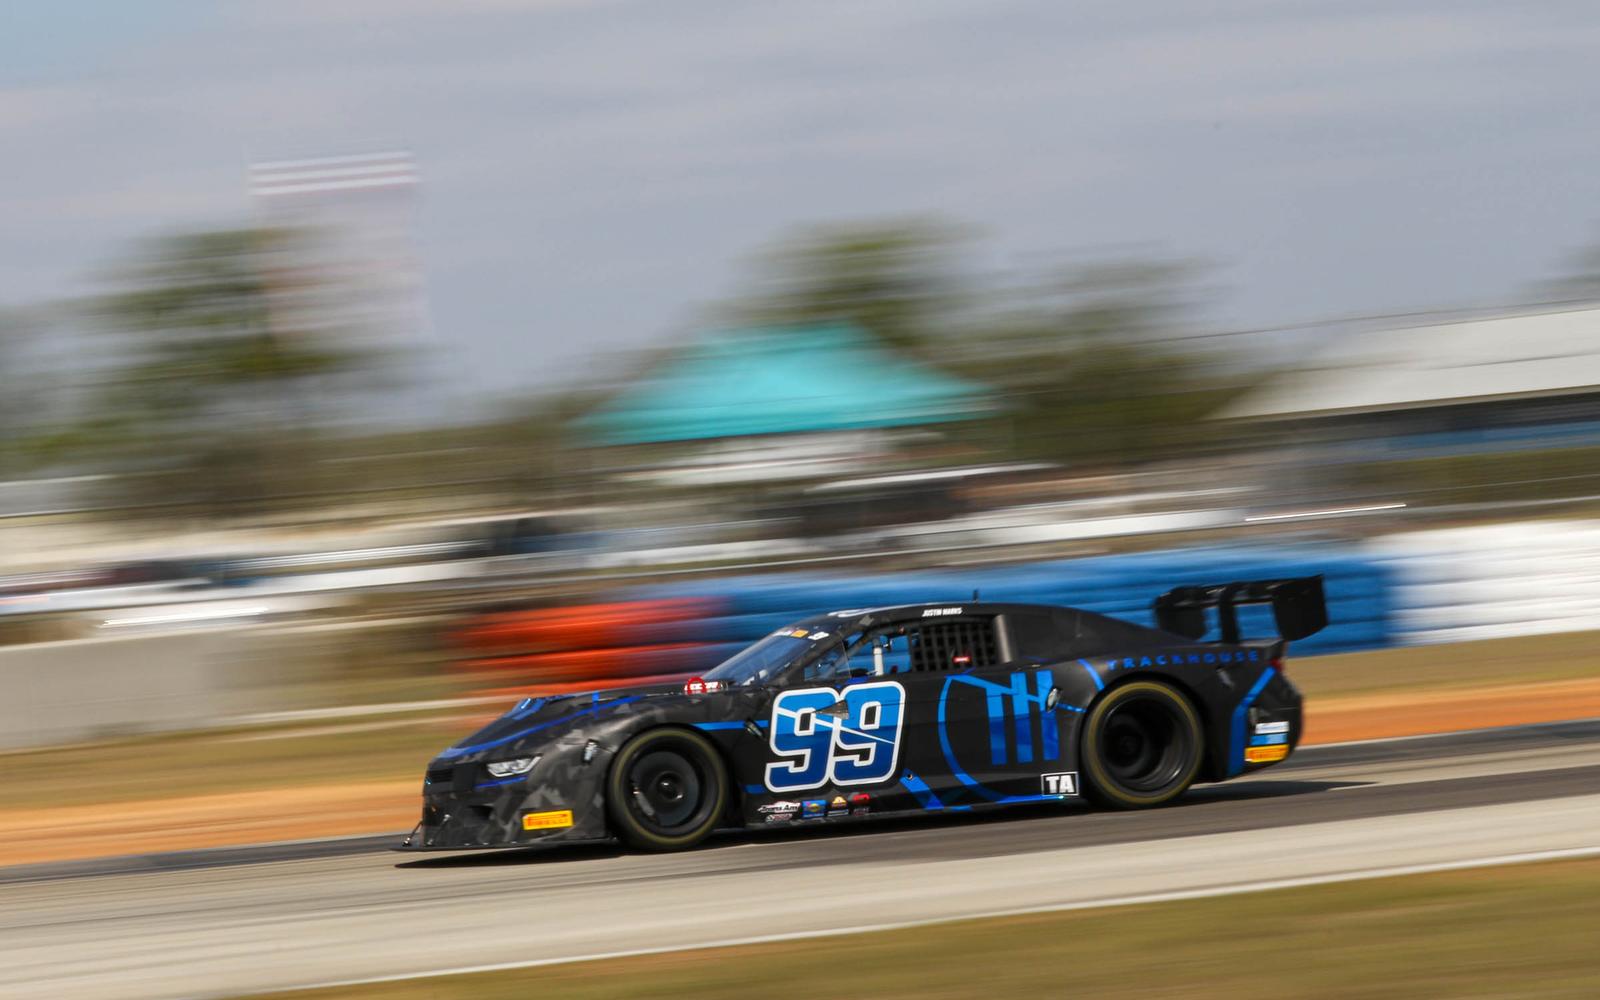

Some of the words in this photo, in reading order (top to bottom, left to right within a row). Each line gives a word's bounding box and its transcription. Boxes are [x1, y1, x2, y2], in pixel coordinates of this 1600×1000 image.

[1107, 650, 1258, 670] TRACKHOUSE
[764, 681, 906, 793] 99
[1045, 774, 1075, 794] TA
